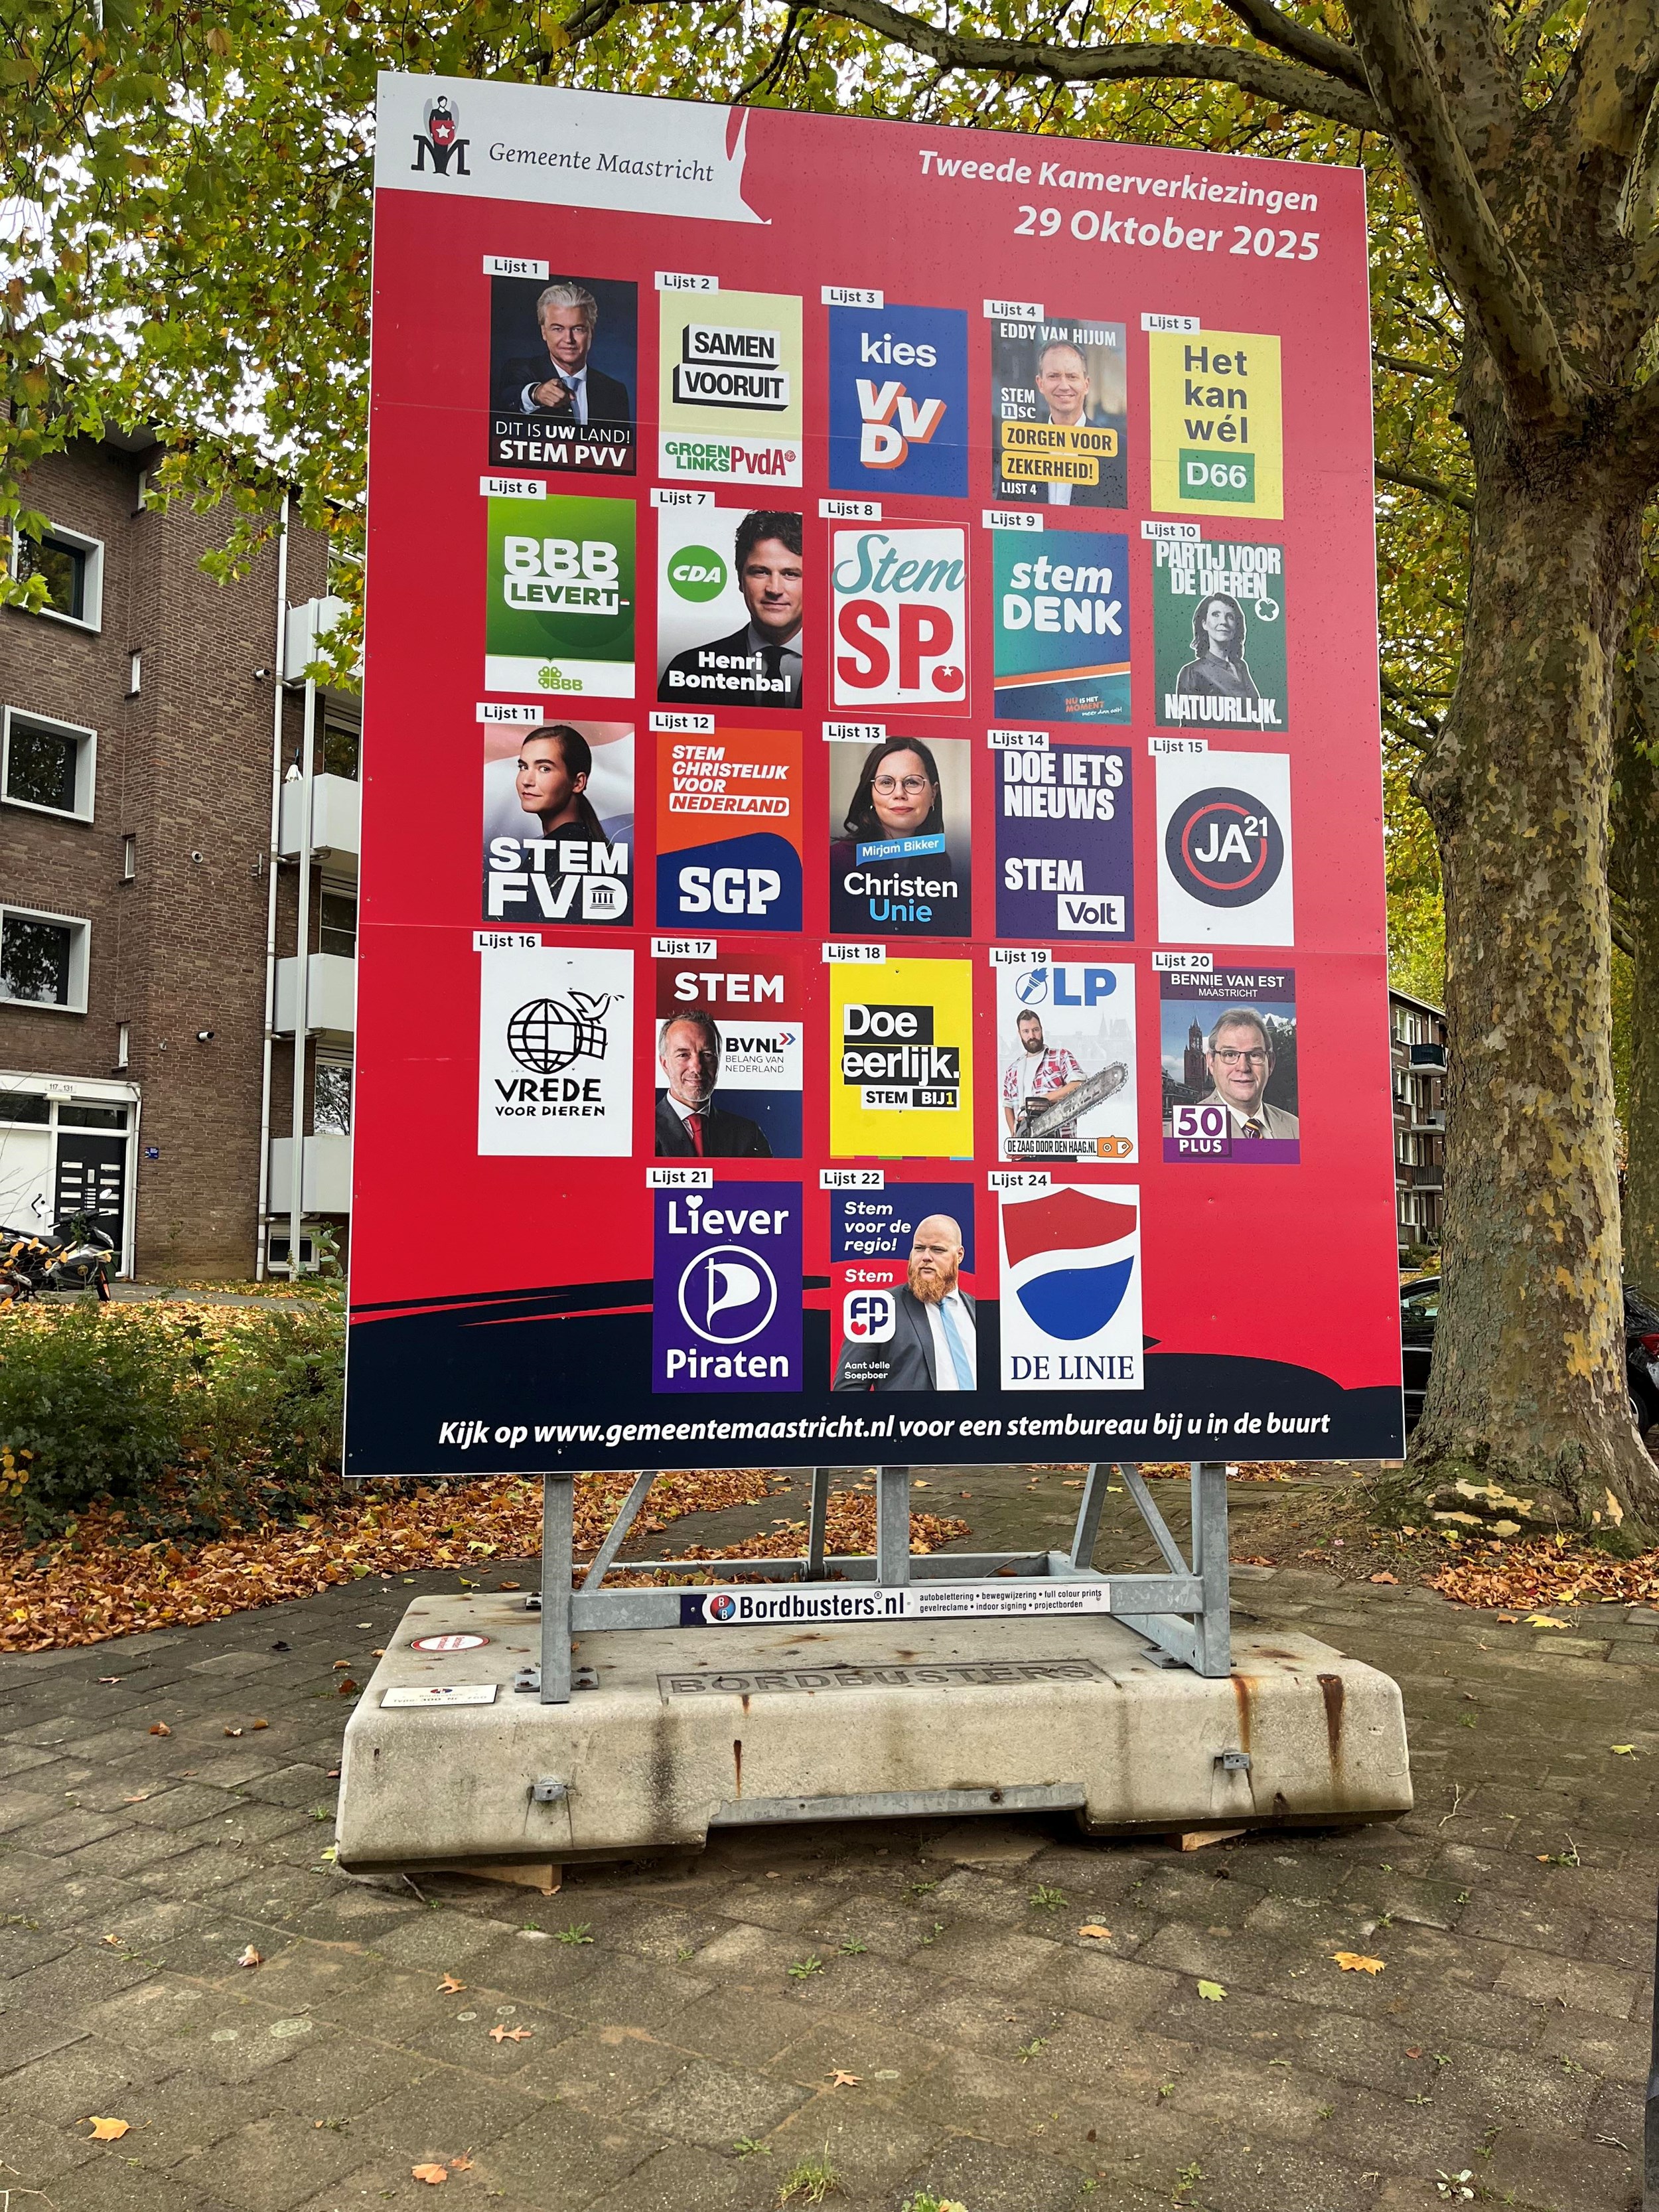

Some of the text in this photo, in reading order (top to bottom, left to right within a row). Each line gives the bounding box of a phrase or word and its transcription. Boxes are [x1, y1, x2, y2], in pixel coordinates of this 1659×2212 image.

[489, 143, 714, 183] Gemeente Maastricht
[918, 150, 1318, 215] Tweede Kamerverkiezingen
[1014, 205, 1321, 261] 29 Oktober 2025
[664, 275, 709, 289] Lijst 2
[1001, 323, 1116, 346] EDDY VAN HIJUM
[1149, 317, 1192, 330] Lijst 5
[695, 331, 774, 359] SAMEN
[861, 332, 937, 367] kies
[1184, 344, 1248, 376] Het
[685, 372, 784, 399] VOORUIT
[1001, 388, 1035, 404] STEM
[1185, 378, 1247, 409] kan
[496, 421, 630, 444] DIT IS UW LAND!
[1007, 427, 1112, 451] ZORGEN VOOR
[1184, 414, 1248, 443] wél
[500, 439, 626, 467] STEM PVV
[666, 441, 730, 458] GROEN
[731, 446, 786, 476] PvdA
[676, 456, 730, 472] LINKS
[1007, 457, 1093, 479] ZEKERHEID!
[1187, 462, 1247, 488] D66
[660, 492, 706, 506] Lijst 7
[1001, 482, 1037, 495] LIJST 4
[1145, 524, 1196, 538] Lijst 10
[504, 536, 619, 581] BBB
[832, 534, 967, 595] Stem
[1156, 541, 1281, 574] PARTIJ VOOR
[672, 565, 721, 583] CDA
[1010, 555, 1113, 594] stem
[1171, 568, 1267, 598] DE DIEREN
[511, 583, 618, 607] LEVERT
[1003, 593, 1122, 636] DENK
[698, 651, 762, 671] Henri
[551, 678, 583, 691] BBB
[669, 670, 791, 693] Bontenbal
[1066, 701, 1104, 712] MOMENT
[1165, 694, 1281, 724] NATUURLIJK.
[656, 715, 709, 729] Lijst 12
[672, 745, 725, 760] STEM
[1154, 741, 1202, 753] Lijst 15
[672, 761, 790, 780] CHRISTELIJK
[1004, 751, 1123, 787] DOE IETS
[672, 777, 725, 793] VOOR
[672, 796, 787, 814] NEDERLAND
[1004, 785, 1114, 821] NIEUWS
[488, 836, 628, 875] STEM
[862, 839, 939, 857] Mirjam Bikker
[844, 872, 958, 899] Christen
[1005, 857, 1084, 892] STEM
[488, 871, 628, 920] FVD
[679, 867, 780, 915] SGP
[869, 898, 932, 922] Unie
[1066, 901, 1118, 925] Volt
[657, 941, 711, 955] Lijst 17
[1156, 955, 1209, 968] Lijst 20
[674, 972, 784, 1003] STEM
[1054, 968, 1117, 1006] LP
[1171, 974, 1285, 988] BENNIE VAN EST
[1198, 988, 1258, 998] MAASTRICHT
[844, 1004, 917, 1037] Doe
[725, 1037, 784, 1053] BVNL
[725, 1055, 763, 1064] BELANG
[725, 1065, 784, 1073] NEDERLAND
[843, 1045, 960, 1086] eerlijk.
[495, 1078, 601, 1102] VREDE
[865, 1090, 954, 1105] STEM BIJ1
[495, 1106, 605, 1116] VOOR DIEREN
[1178, 1108, 1223, 1136] 50
[1008, 1139, 1096, 1153] DE ZAAG DOOR DEN HAAG.NL
[1179, 1140, 1222, 1153] PLUS
[824, 1173, 880, 1187] Lijst 22
[992, 1174, 1047, 1188] Lijst 24
[668, 1195, 789, 1234] Liever
[844, 1201, 893, 1215] Stem
[844, 1220, 911, 1234] voor de
[844, 1238, 897, 1254] regio!
[844, 1268, 893, 1283] Stem
[666, 1348, 788, 1378] Piraten
[844, 1361, 890, 1370] Aant Jelle
[1011, 1356, 1134, 1380] DE LINIE
[844, 1372, 888, 1380] Soepboer
[439, 1412, 1330, 1449] Kijk op www.gemeentemaastricht.nl voor een stembureau bij u in de buurt
[920, 1593, 974, 1601] autobelettering
[982, 1591, 1037, 1600] bewegwijzering
[920, 1603, 968, 1613] gevelreclame
[1001, 1602, 1027, 1611] signing
[1035, 1601, 1082, 1610] projectborden
[671, 1665, 1094, 1693] BORDBUSTERS
